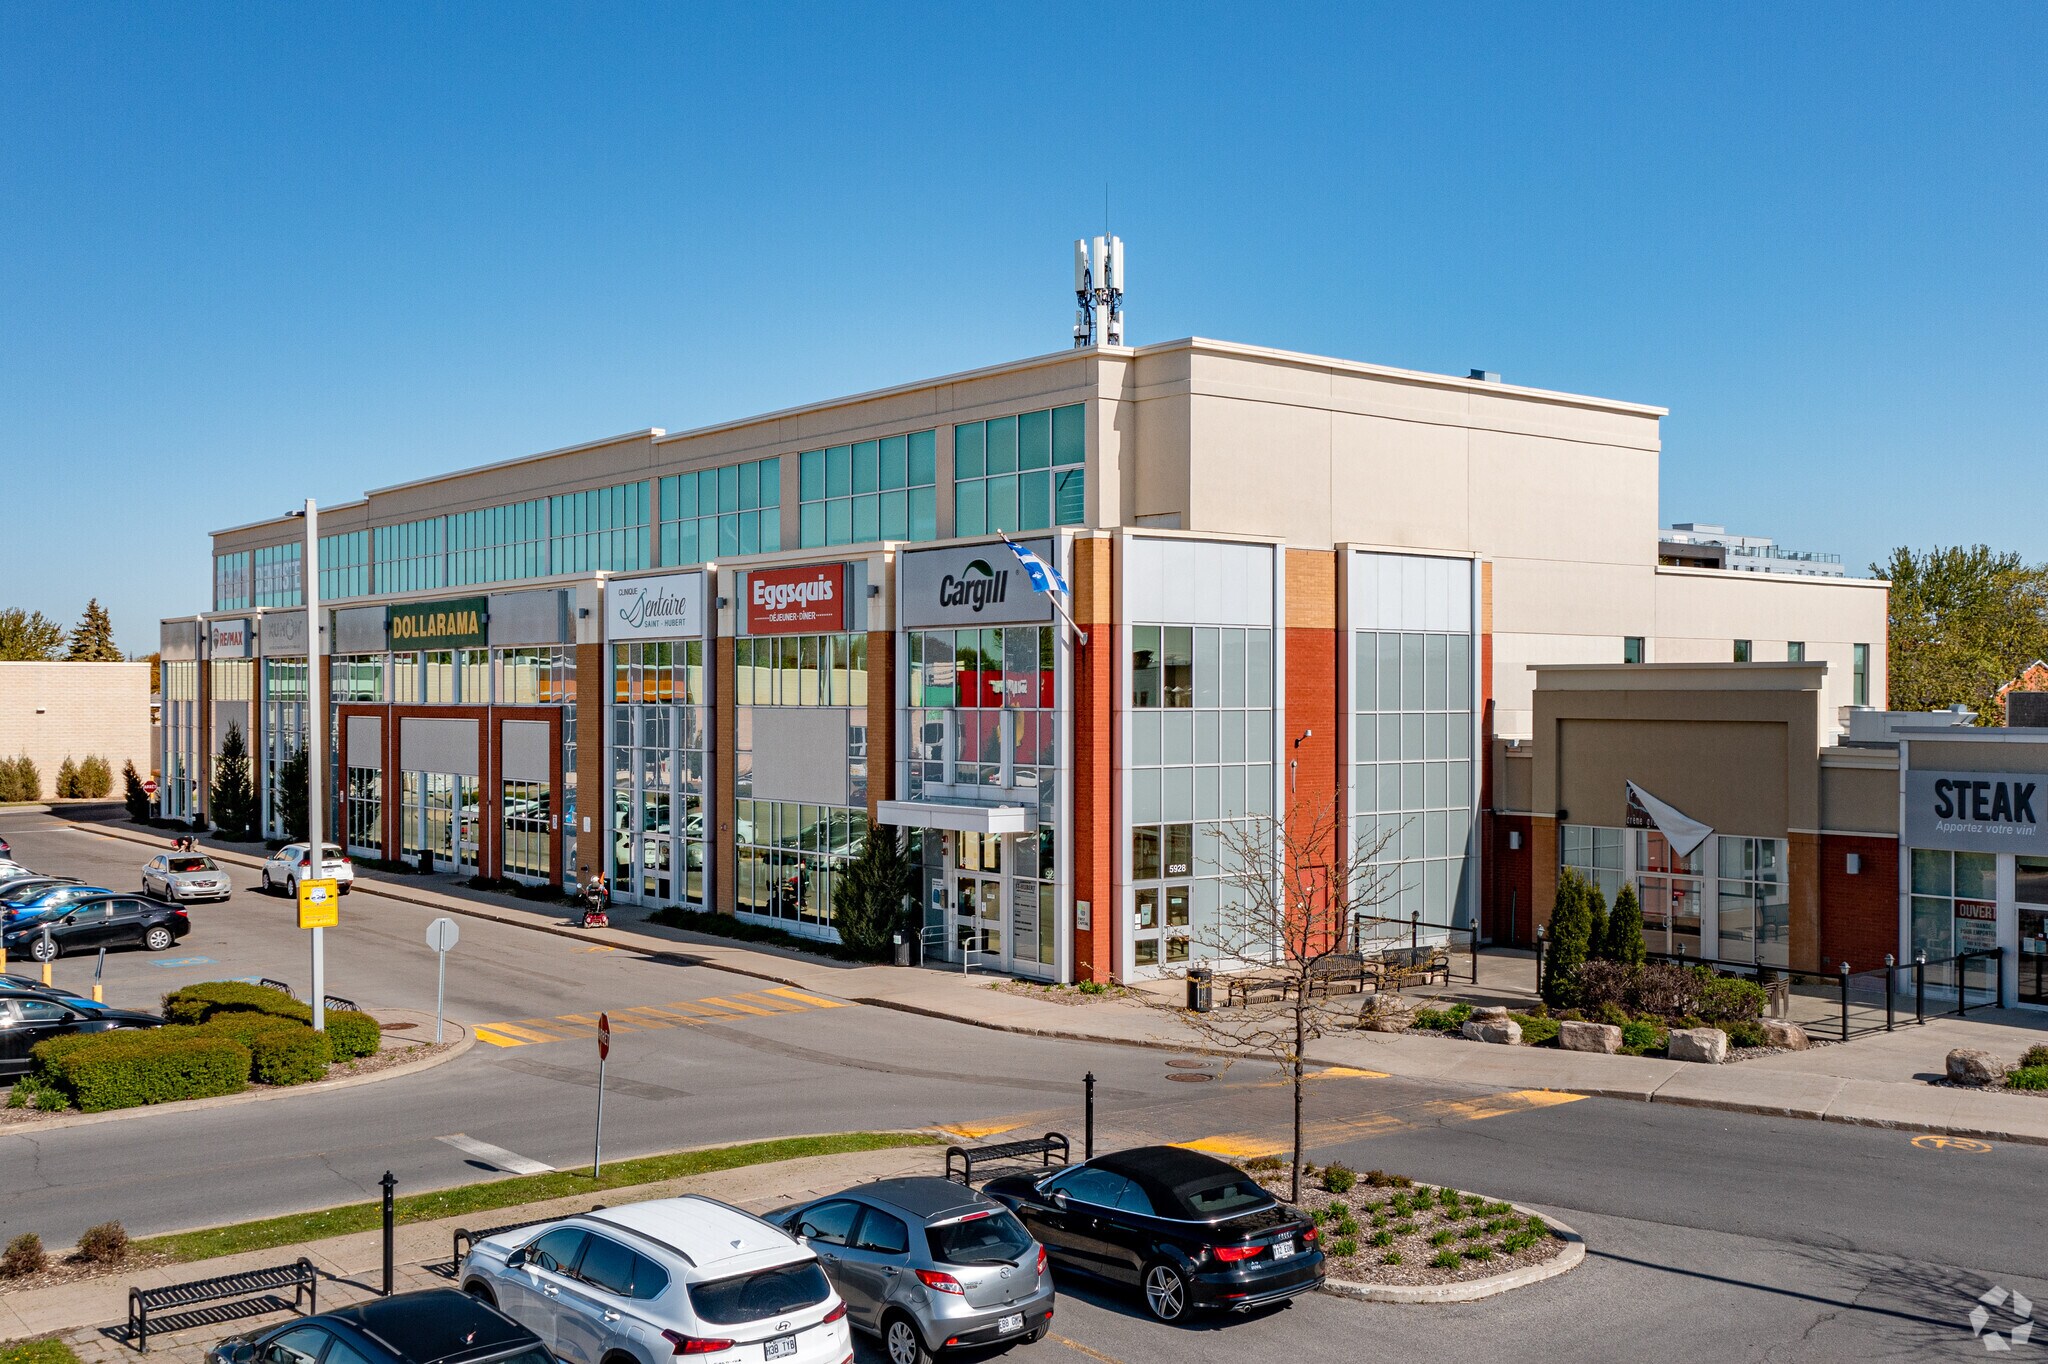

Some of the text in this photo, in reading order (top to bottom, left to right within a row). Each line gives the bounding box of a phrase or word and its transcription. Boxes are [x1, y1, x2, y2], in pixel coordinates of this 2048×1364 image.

[255, 560, 301, 593] DENTISTE
[618, 587, 638, 596] CLINIQUE
[753, 574, 833, 610] Eggsquis
[940, 570, 1008, 612] Cargill
[619, 587, 687, 628] Sentaire
[393, 610, 479, 639] DOLLARAMA
[644, 620, 660, 628] SAINT
[665, 618, 686, 627] HUBERT
[219, 631, 243, 646] RE/MAX
[1934, 778, 2036, 824] STEAK
[1626, 814, 1643, 826] crème
[1936, 820, 2037, 836] Apportez votre vin!
[1169, 864, 1187, 873] 5928
[782, 1340, 795, 1351] TYB
